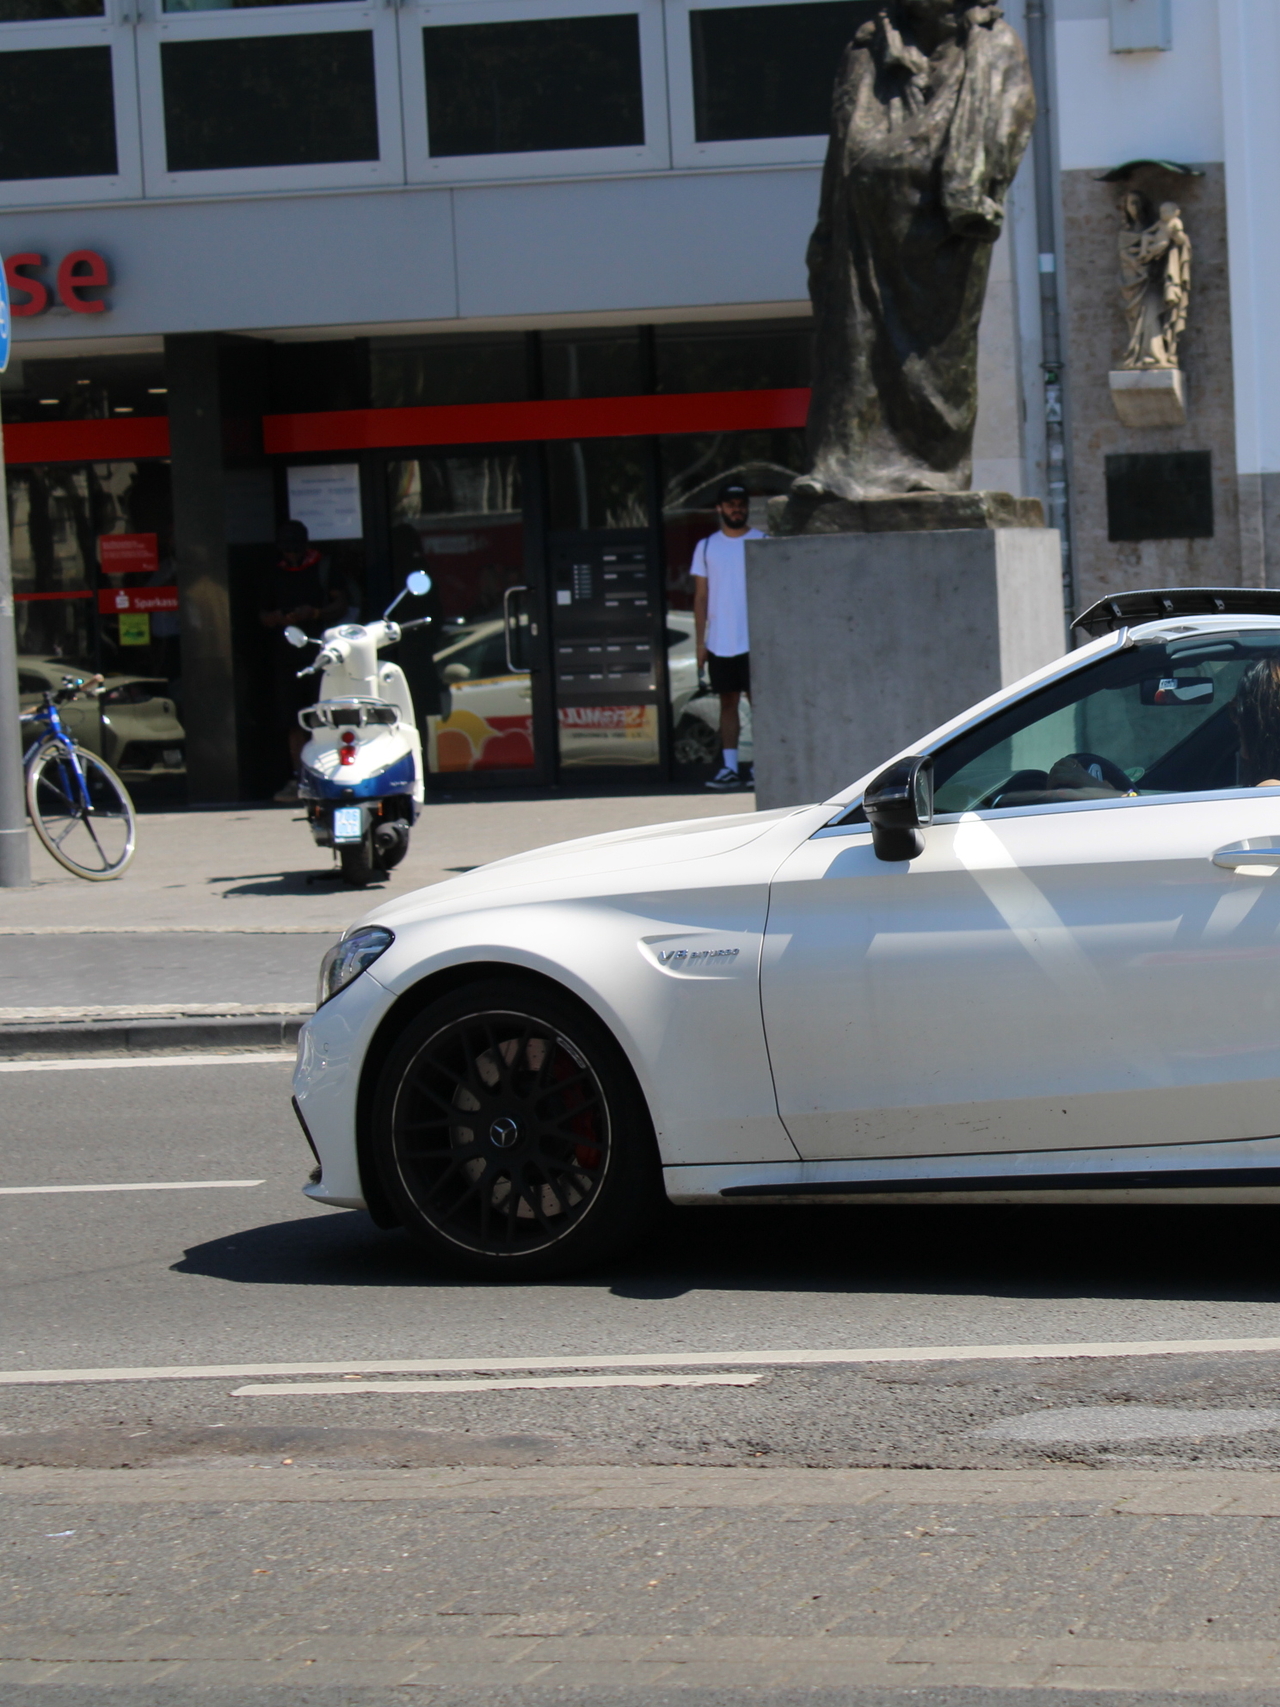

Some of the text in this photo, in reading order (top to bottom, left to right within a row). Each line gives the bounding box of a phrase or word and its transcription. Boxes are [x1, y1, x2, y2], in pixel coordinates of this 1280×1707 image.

[4, 249, 109, 317] se
[660, 947, 741, 962] V8 BITURBO
